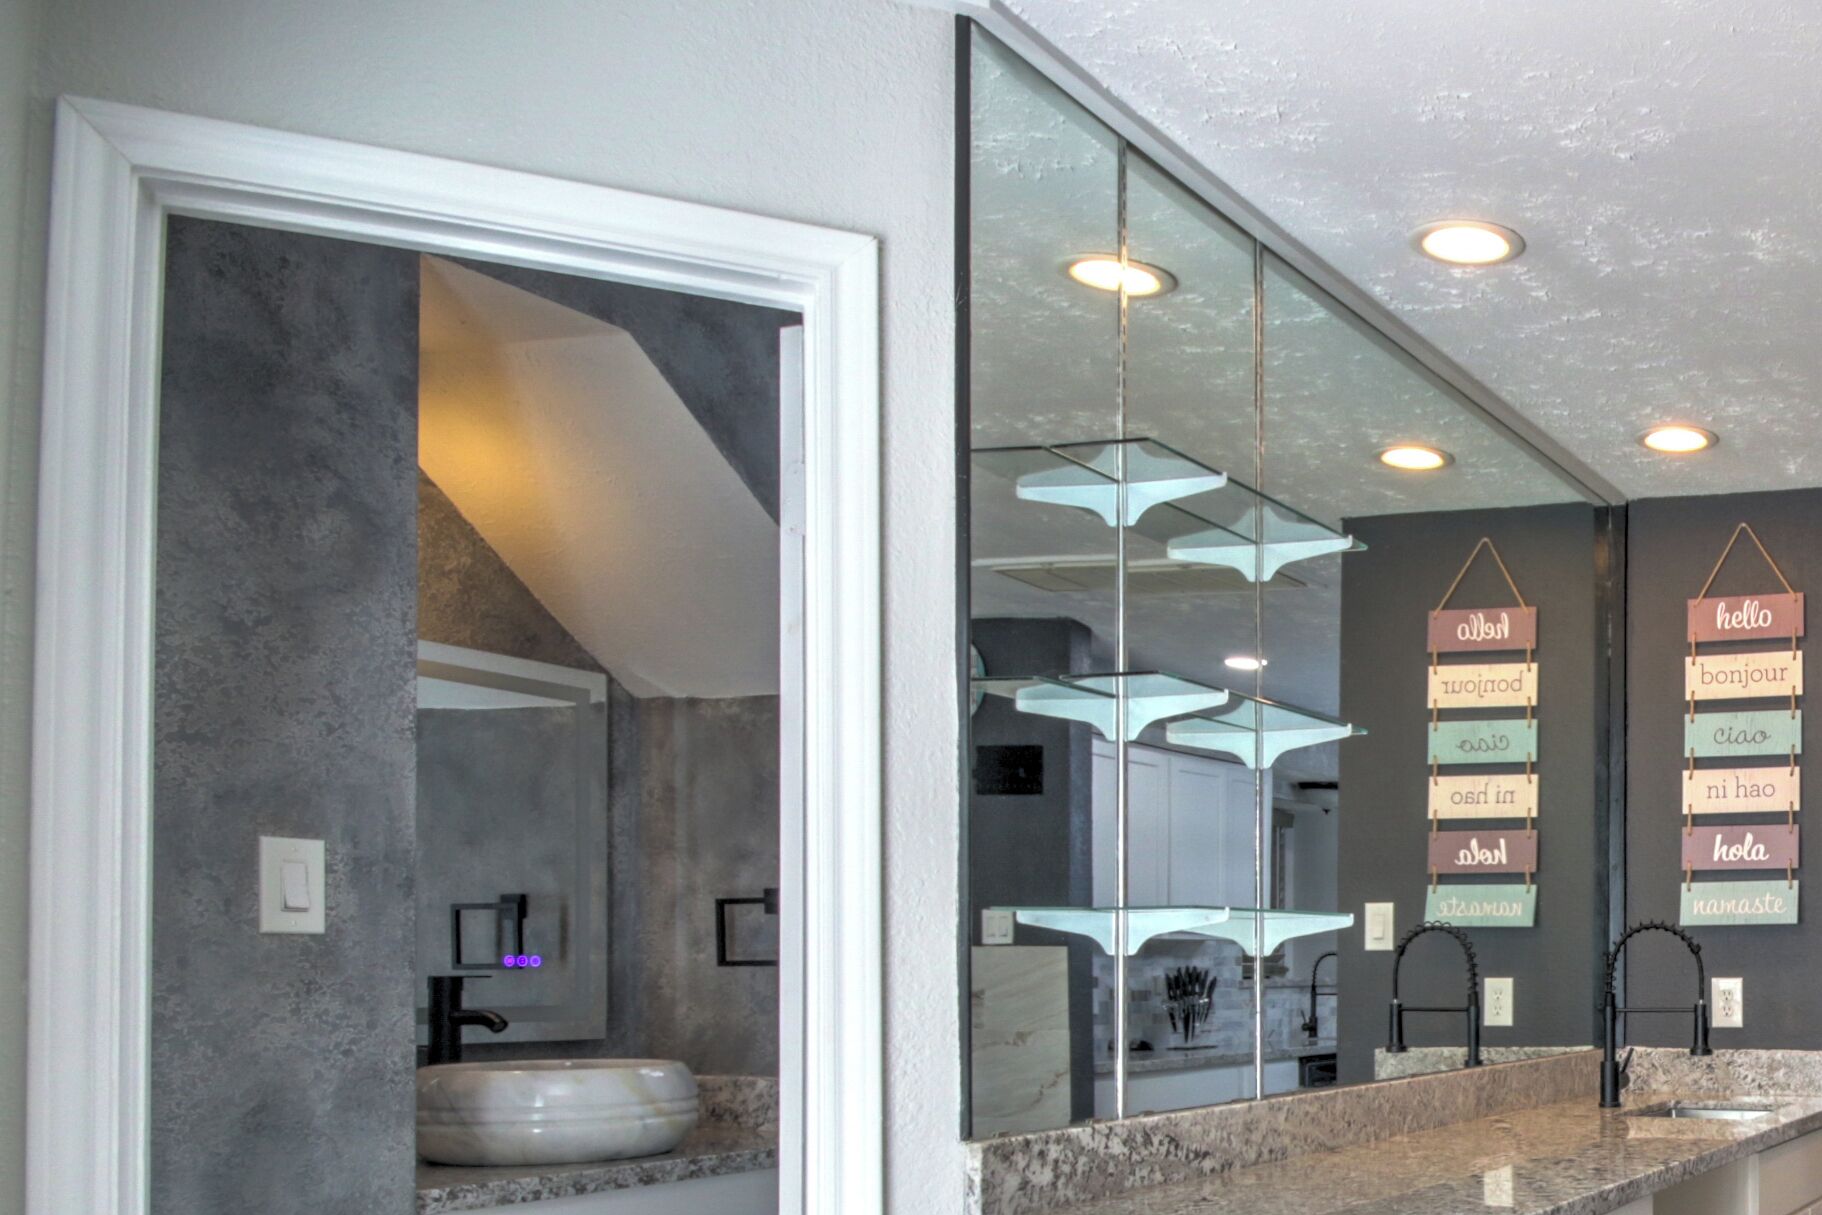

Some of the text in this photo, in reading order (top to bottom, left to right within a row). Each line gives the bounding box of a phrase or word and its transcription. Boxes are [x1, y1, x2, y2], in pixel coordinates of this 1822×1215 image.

[1716, 599, 1772, 630] hello
[1700, 663, 1789, 688] bonjour
[1713, 725, 1771, 746] ciao
[1706, 775, 1776, 799] ni hao
[1713, 832, 1769, 862] hola
[1692, 892, 1787, 916] namaste
